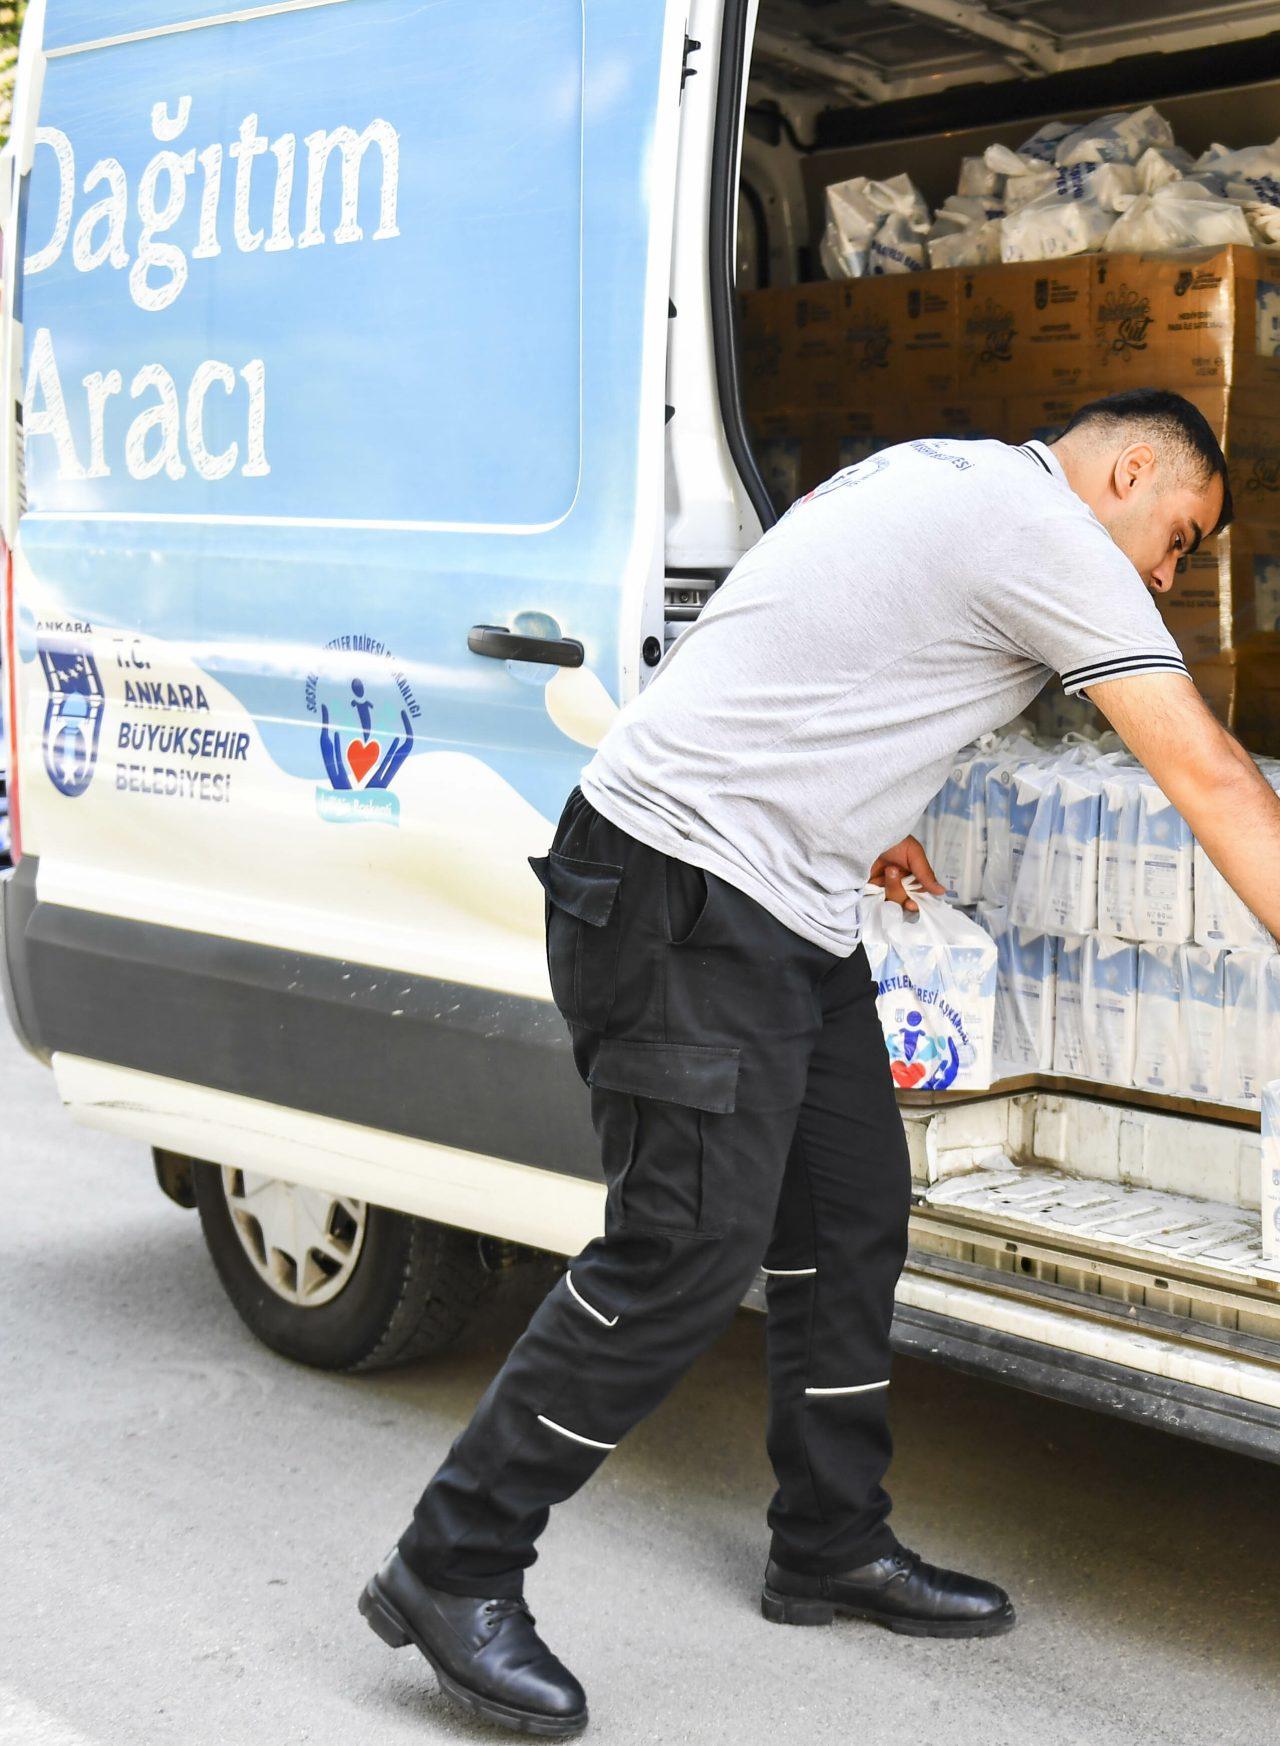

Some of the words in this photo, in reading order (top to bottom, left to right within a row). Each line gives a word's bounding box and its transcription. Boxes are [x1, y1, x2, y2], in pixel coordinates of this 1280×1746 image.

[23, 328, 271, 480] Aracı
[123, 680, 211, 714] ANKARA
[117, 722, 251, 761] BÜYÜKŞEHİR
[115, 762, 231, 803] BELEDİYESİ
